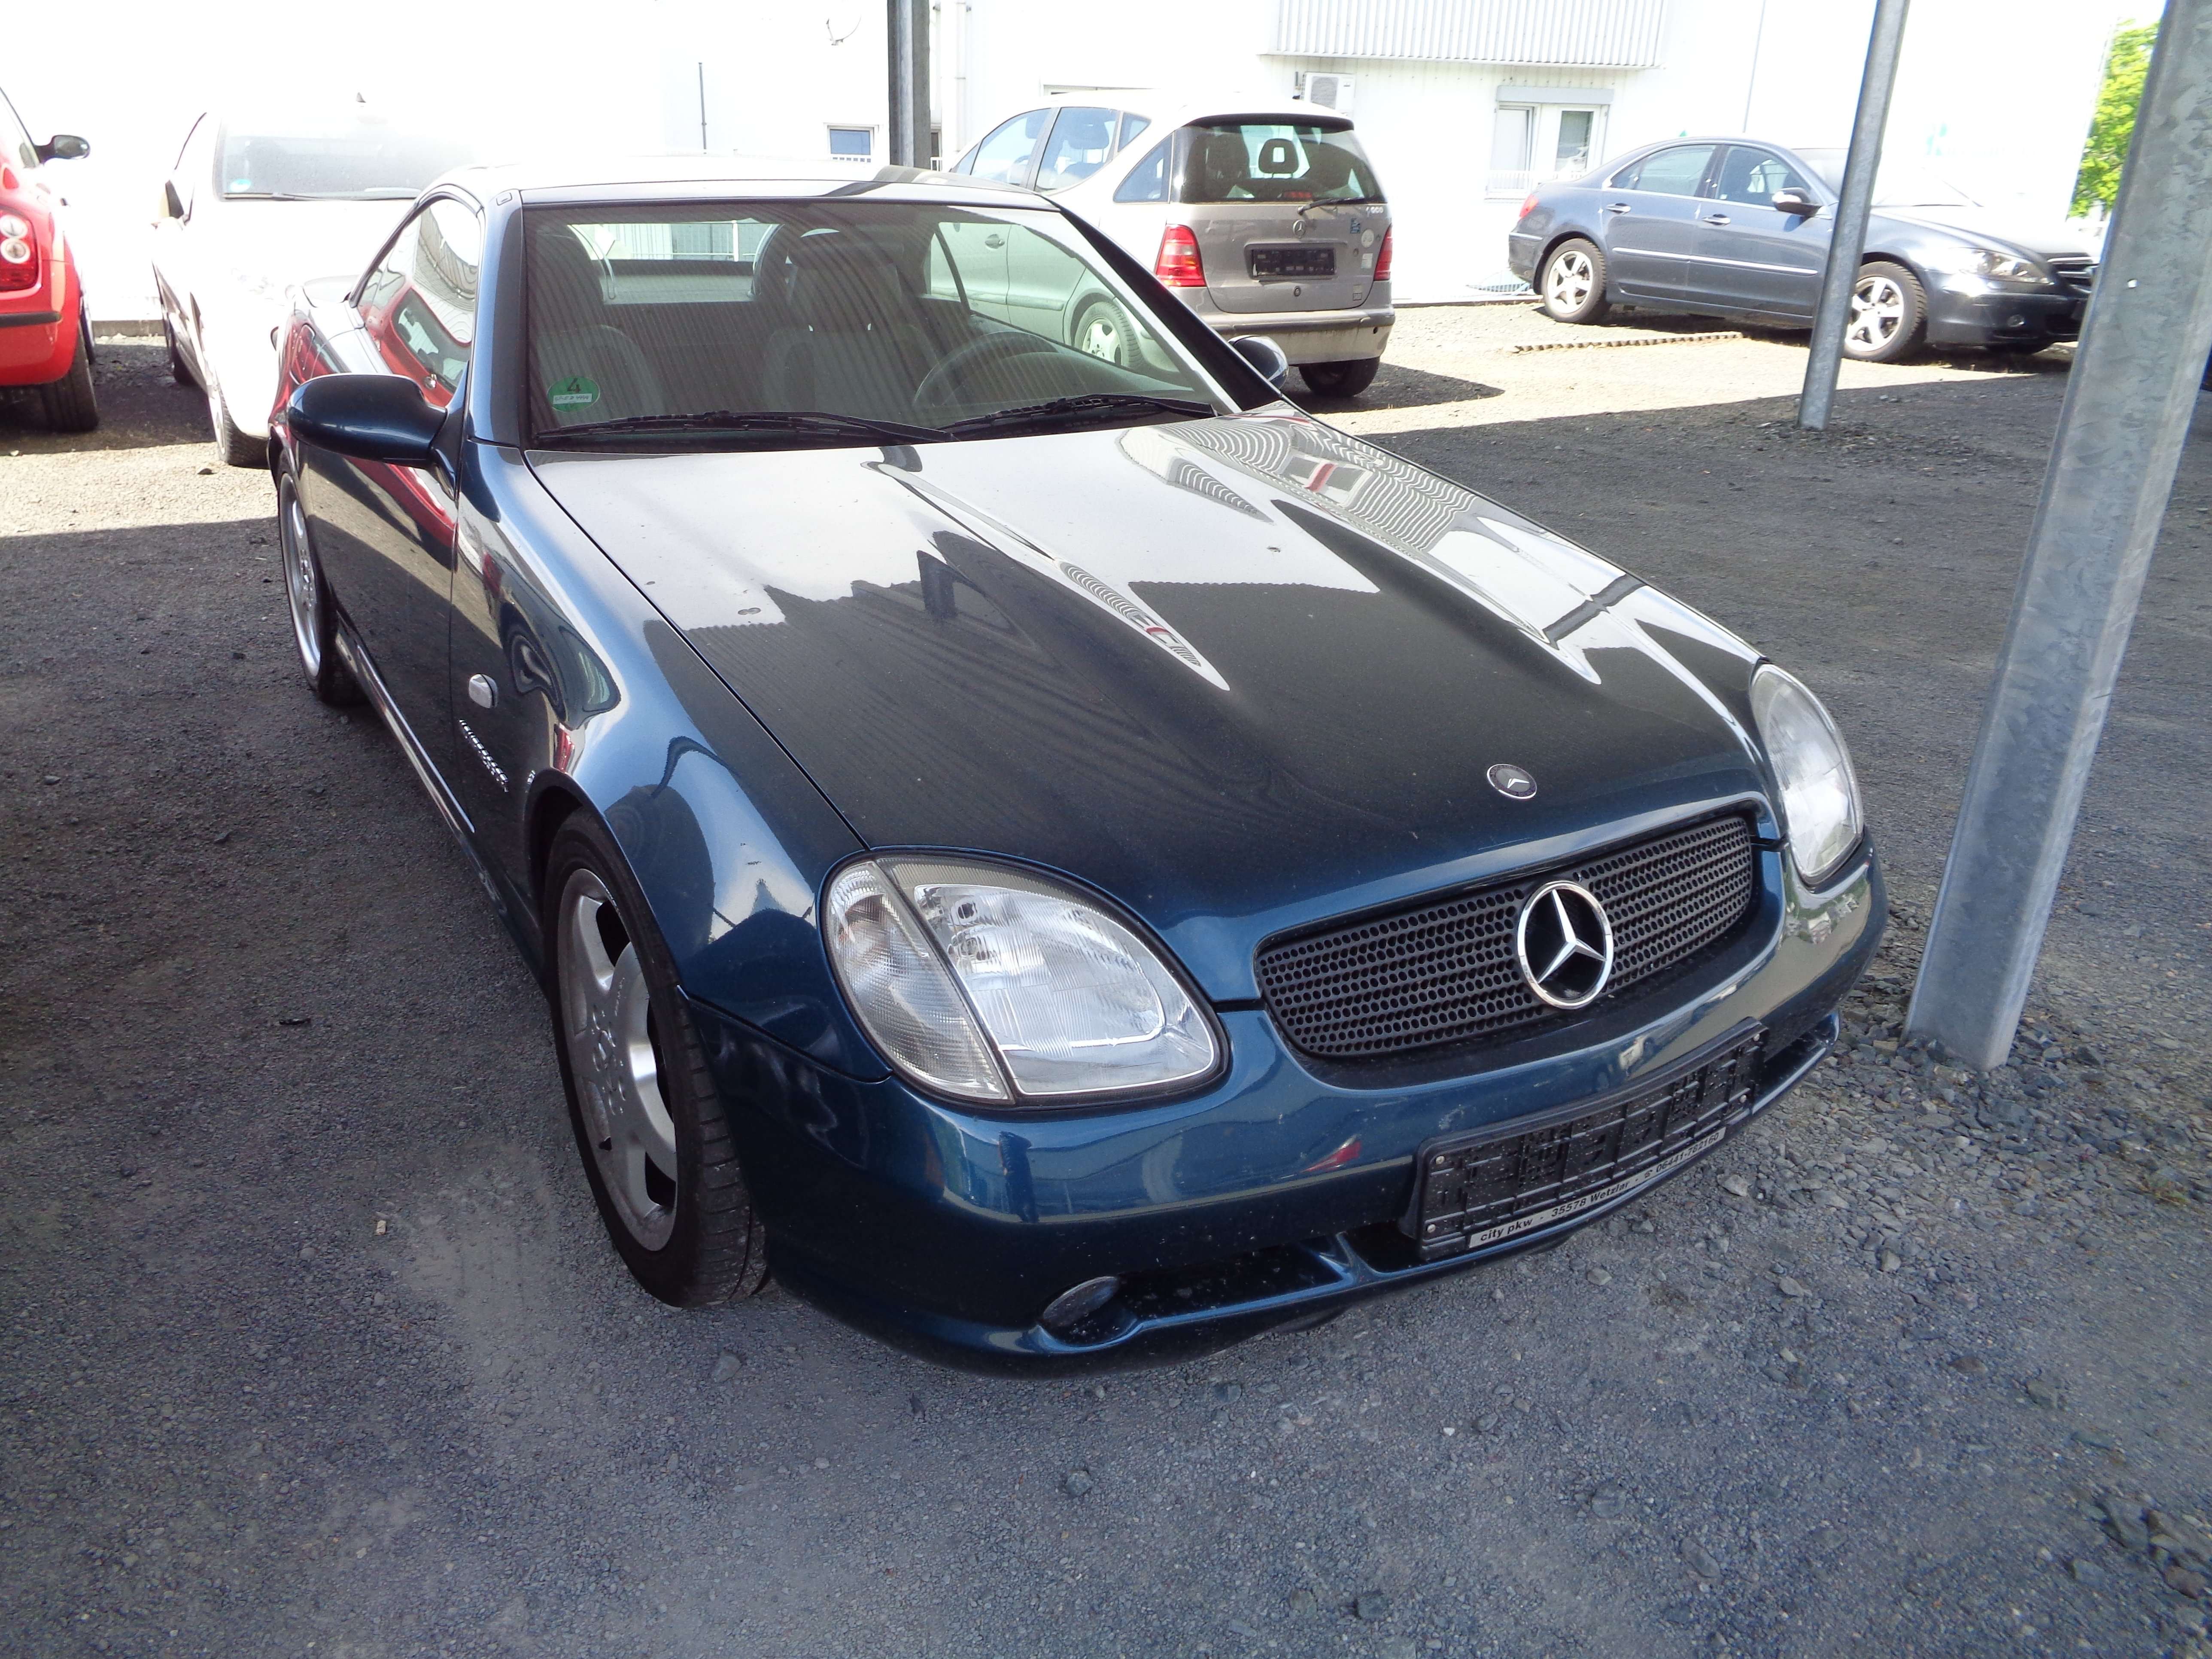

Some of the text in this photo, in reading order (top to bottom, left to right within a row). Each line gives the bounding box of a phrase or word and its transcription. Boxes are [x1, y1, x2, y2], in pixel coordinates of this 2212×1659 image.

[567, 378, 581, 393] 4
[1480, 1228, 1504, 1241] city
[1507, 1218, 1533, 1234] pkw
[1551, 1198, 1586, 1217] 35578
[1590, 1181, 1630, 1202] Wetzlar
